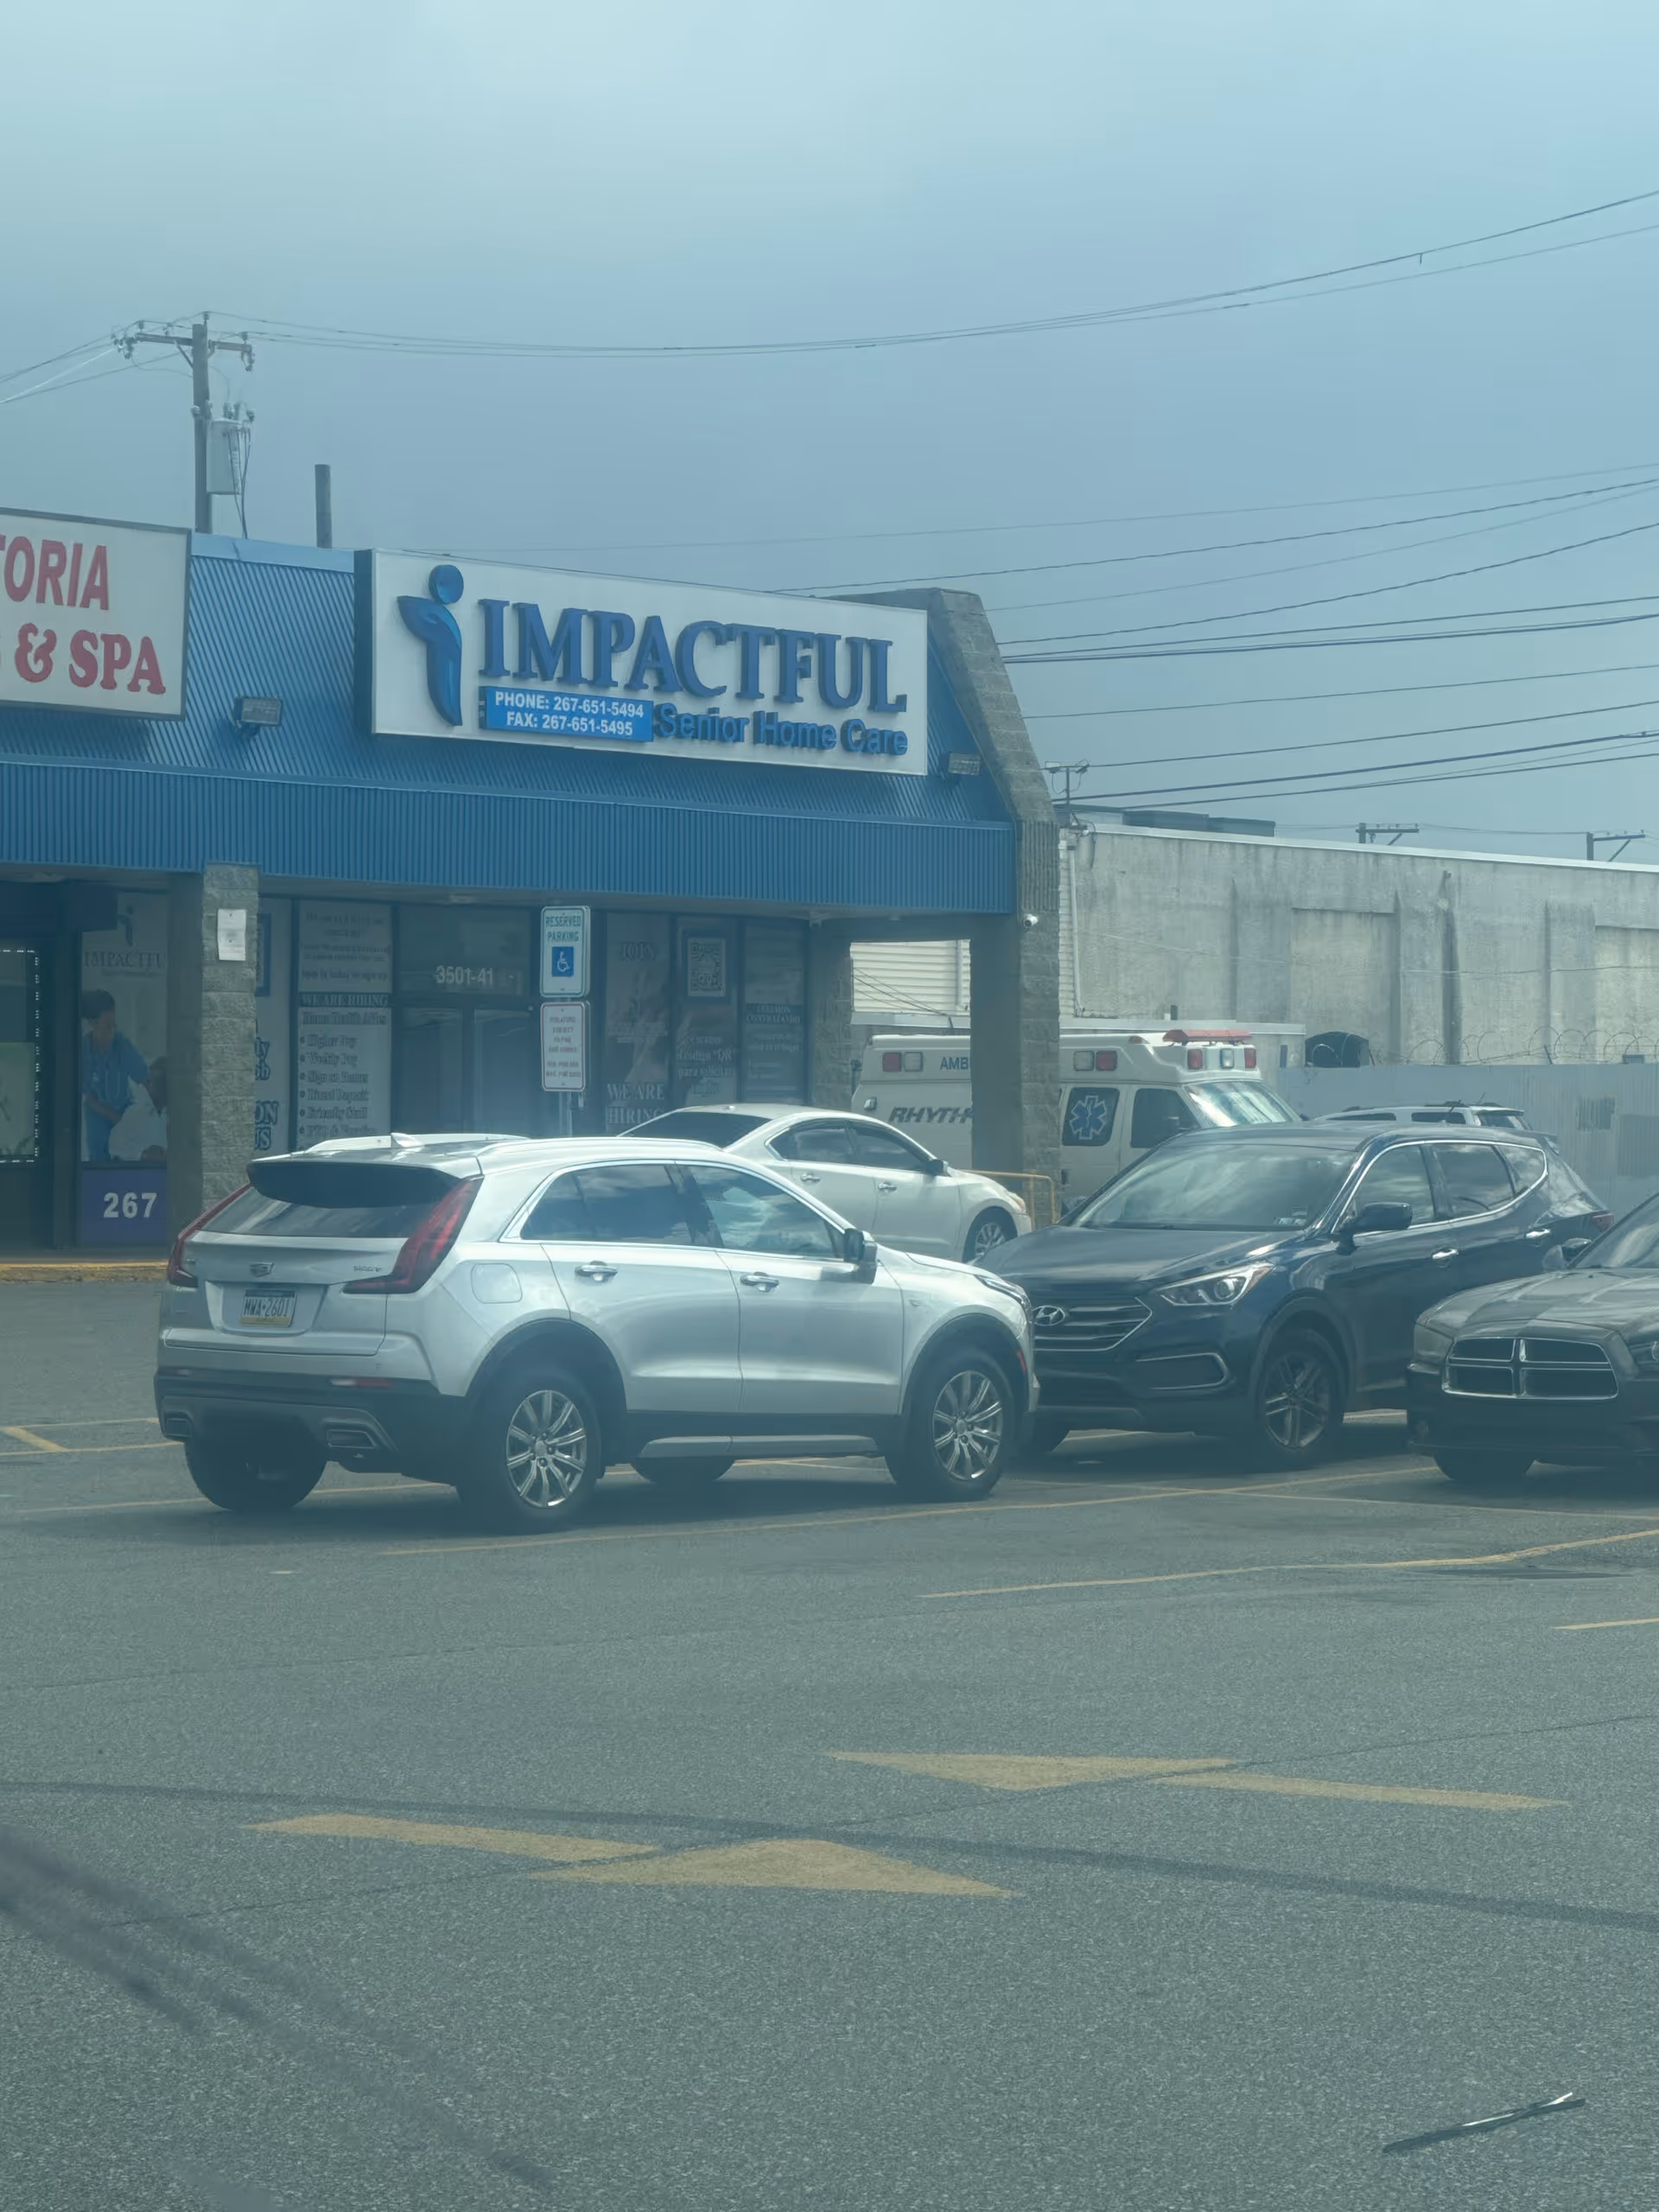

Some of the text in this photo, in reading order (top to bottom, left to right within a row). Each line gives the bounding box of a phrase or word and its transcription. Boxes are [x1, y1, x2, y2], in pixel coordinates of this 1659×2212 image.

[0, 534, 109, 610] ORIA
[14, 622, 167, 696] & SPA
[478, 598, 907, 713] IMPACTFUL
[495, 690, 645, 718] PHONE: 267-651-5494
[506, 710, 633, 736] FAX: 267-651-5495
[655, 702, 908, 755] Senior Home Care
[546, 915, 582, 927] RESERVED
[547, 931, 579, 943] PARKING
[84, 951, 166, 968] IMPACTFU
[435, 965, 493, 986] 3501-41
[302, 995, 388, 1007] WE ARE HIRING
[939, 1056, 969, 1071] AMB
[607, 1083, 665, 1101] WE ARE
[888, 1106, 974, 1124] RHYTH
[103, 1192, 158, 1219] 267
